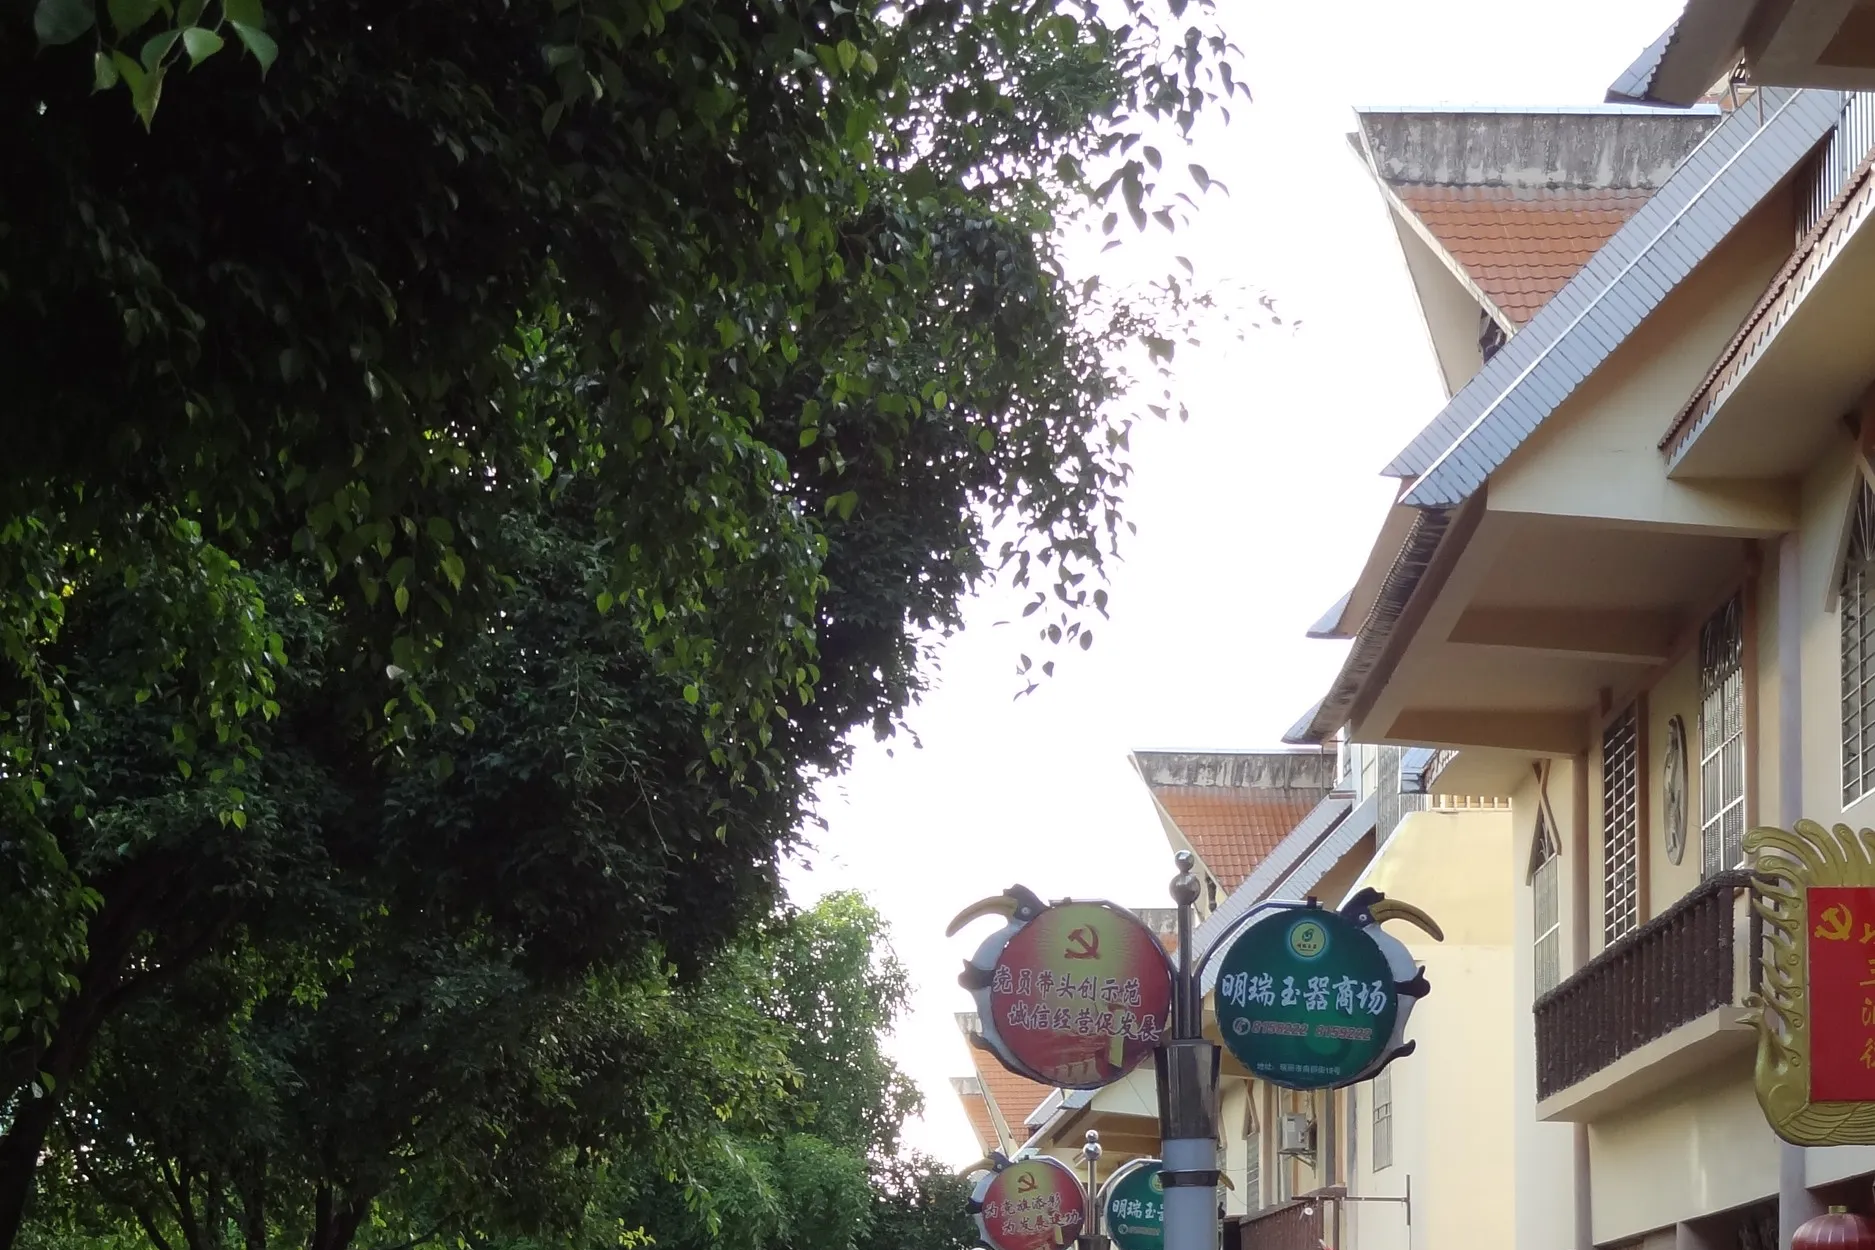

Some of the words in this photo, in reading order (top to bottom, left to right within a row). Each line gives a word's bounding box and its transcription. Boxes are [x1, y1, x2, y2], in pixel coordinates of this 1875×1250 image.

[992, 964, 1142, 1007] 党员带头创示范
[1221, 971, 1387, 1016] 明瑞玉器商场
[1007, 999, 1163, 1042] 诚信经营促发展
